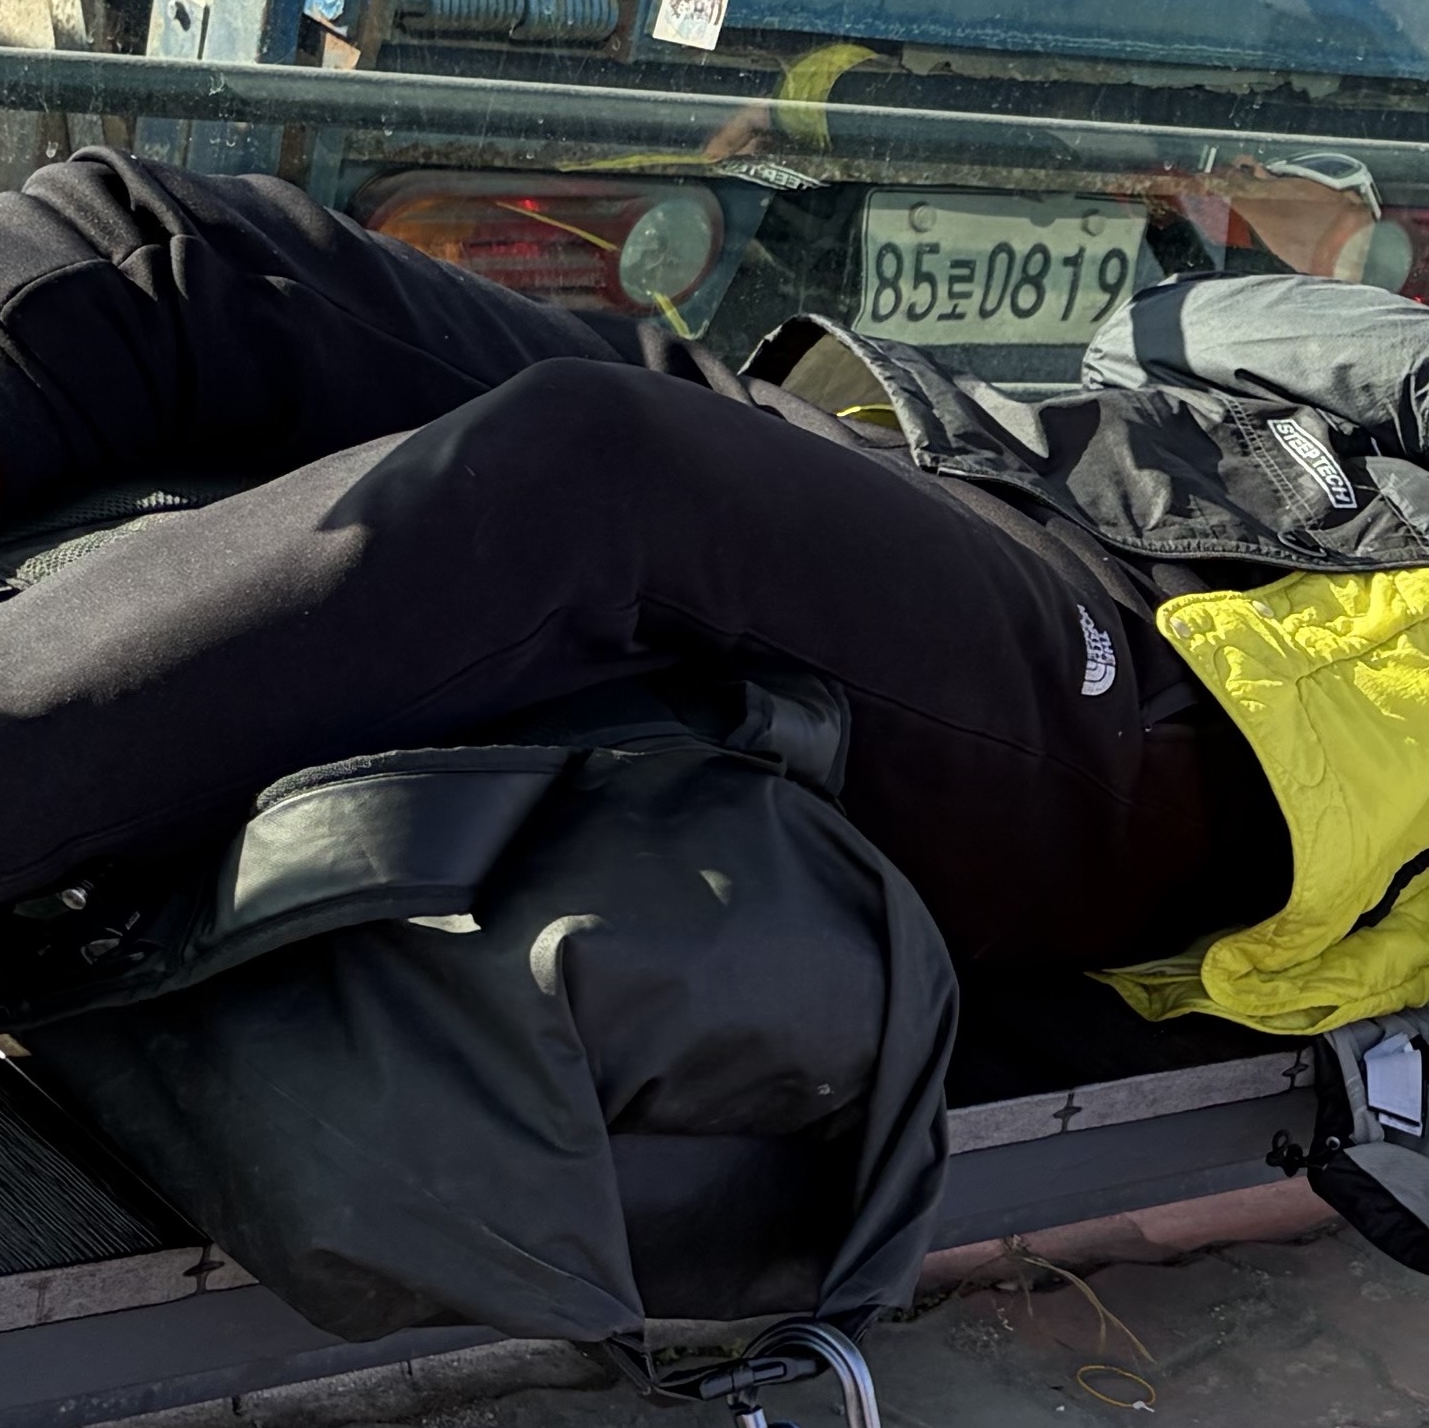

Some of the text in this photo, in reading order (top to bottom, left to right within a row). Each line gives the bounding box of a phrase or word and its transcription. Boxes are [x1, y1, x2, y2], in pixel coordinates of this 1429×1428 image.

[872, 241, 1129, 322] 85로0819
[1276, 422, 1352, 503] STEEP TECH
